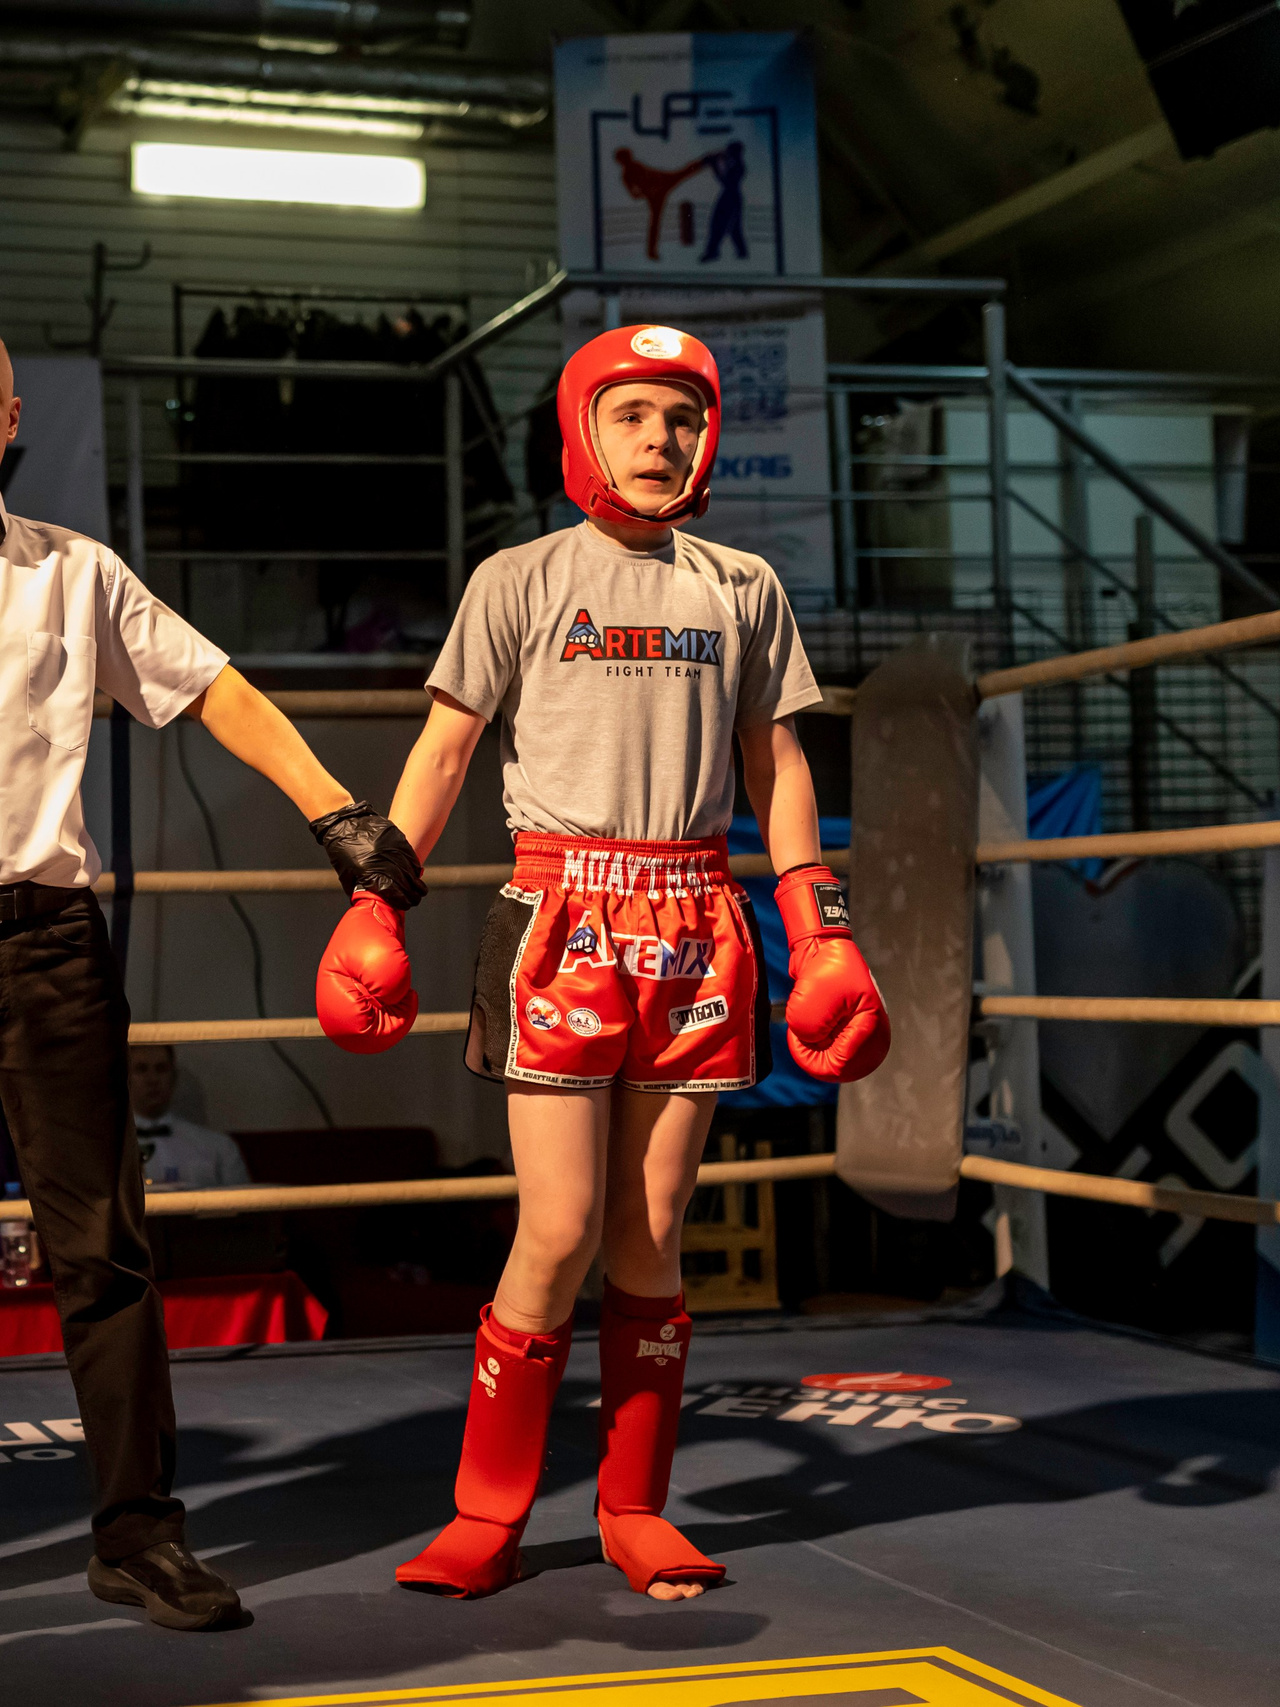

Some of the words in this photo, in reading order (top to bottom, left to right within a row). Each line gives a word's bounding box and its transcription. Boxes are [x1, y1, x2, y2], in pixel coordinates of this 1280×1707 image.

[560, 609, 721, 666] ARTEMIX
[606, 666, 653, 677] FIGHT
[665, 666, 701, 679] TEAM
[557, 910, 716, 980] ATEMIX
